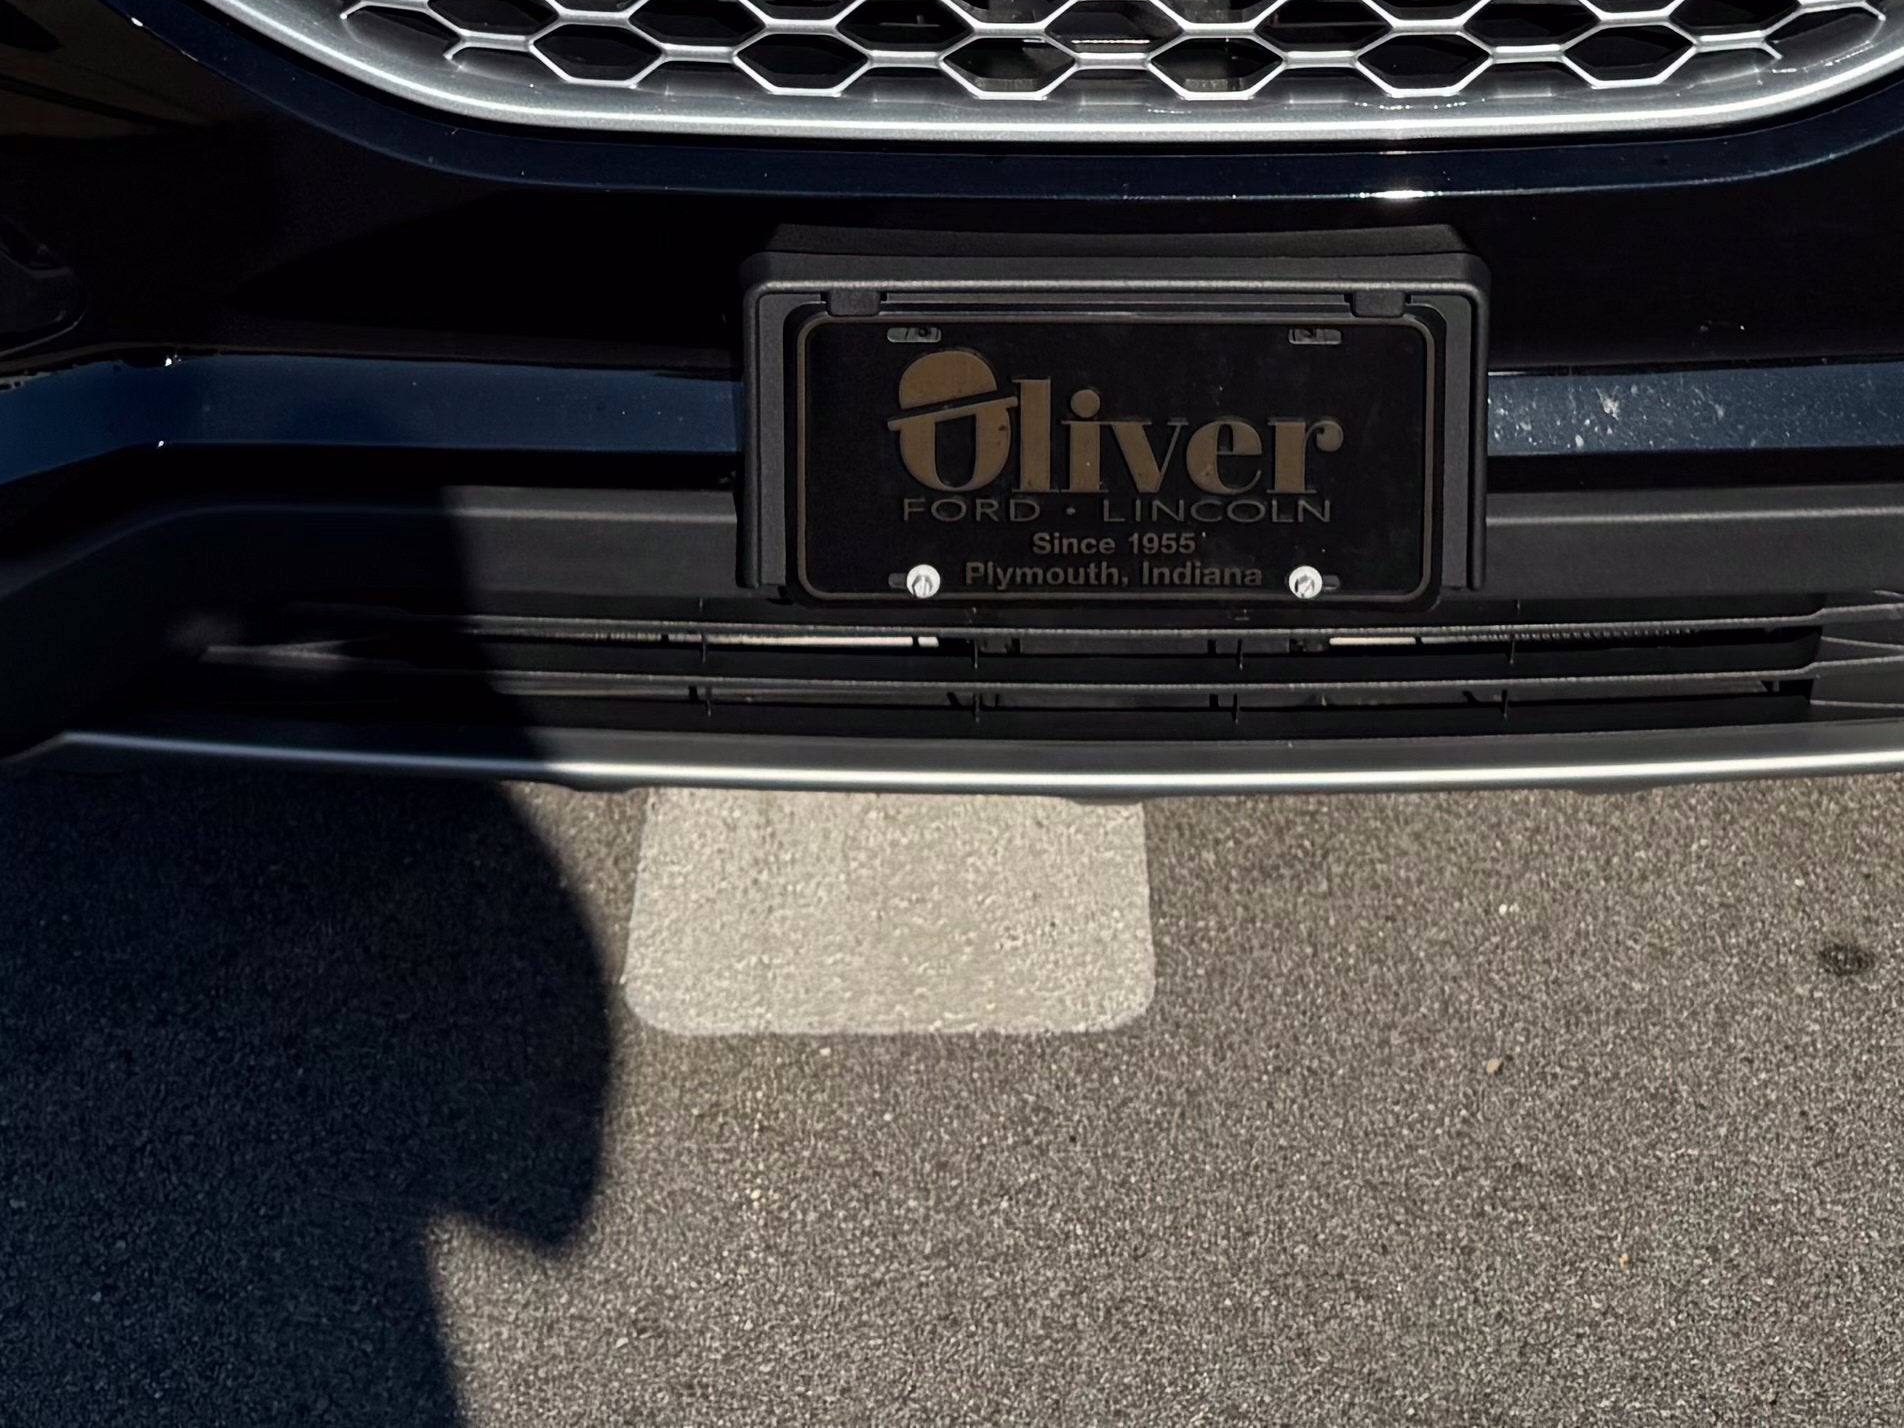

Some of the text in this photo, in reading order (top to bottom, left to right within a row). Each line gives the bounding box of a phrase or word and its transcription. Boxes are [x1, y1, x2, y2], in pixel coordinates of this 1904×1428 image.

[887, 348, 1344, 494] Oliver
[902, 497, 1332, 523] FORD LINCOLN
[1031, 531, 1197, 555] Since 1955
[965, 560, 1263, 591] Plymouth, Indiana
